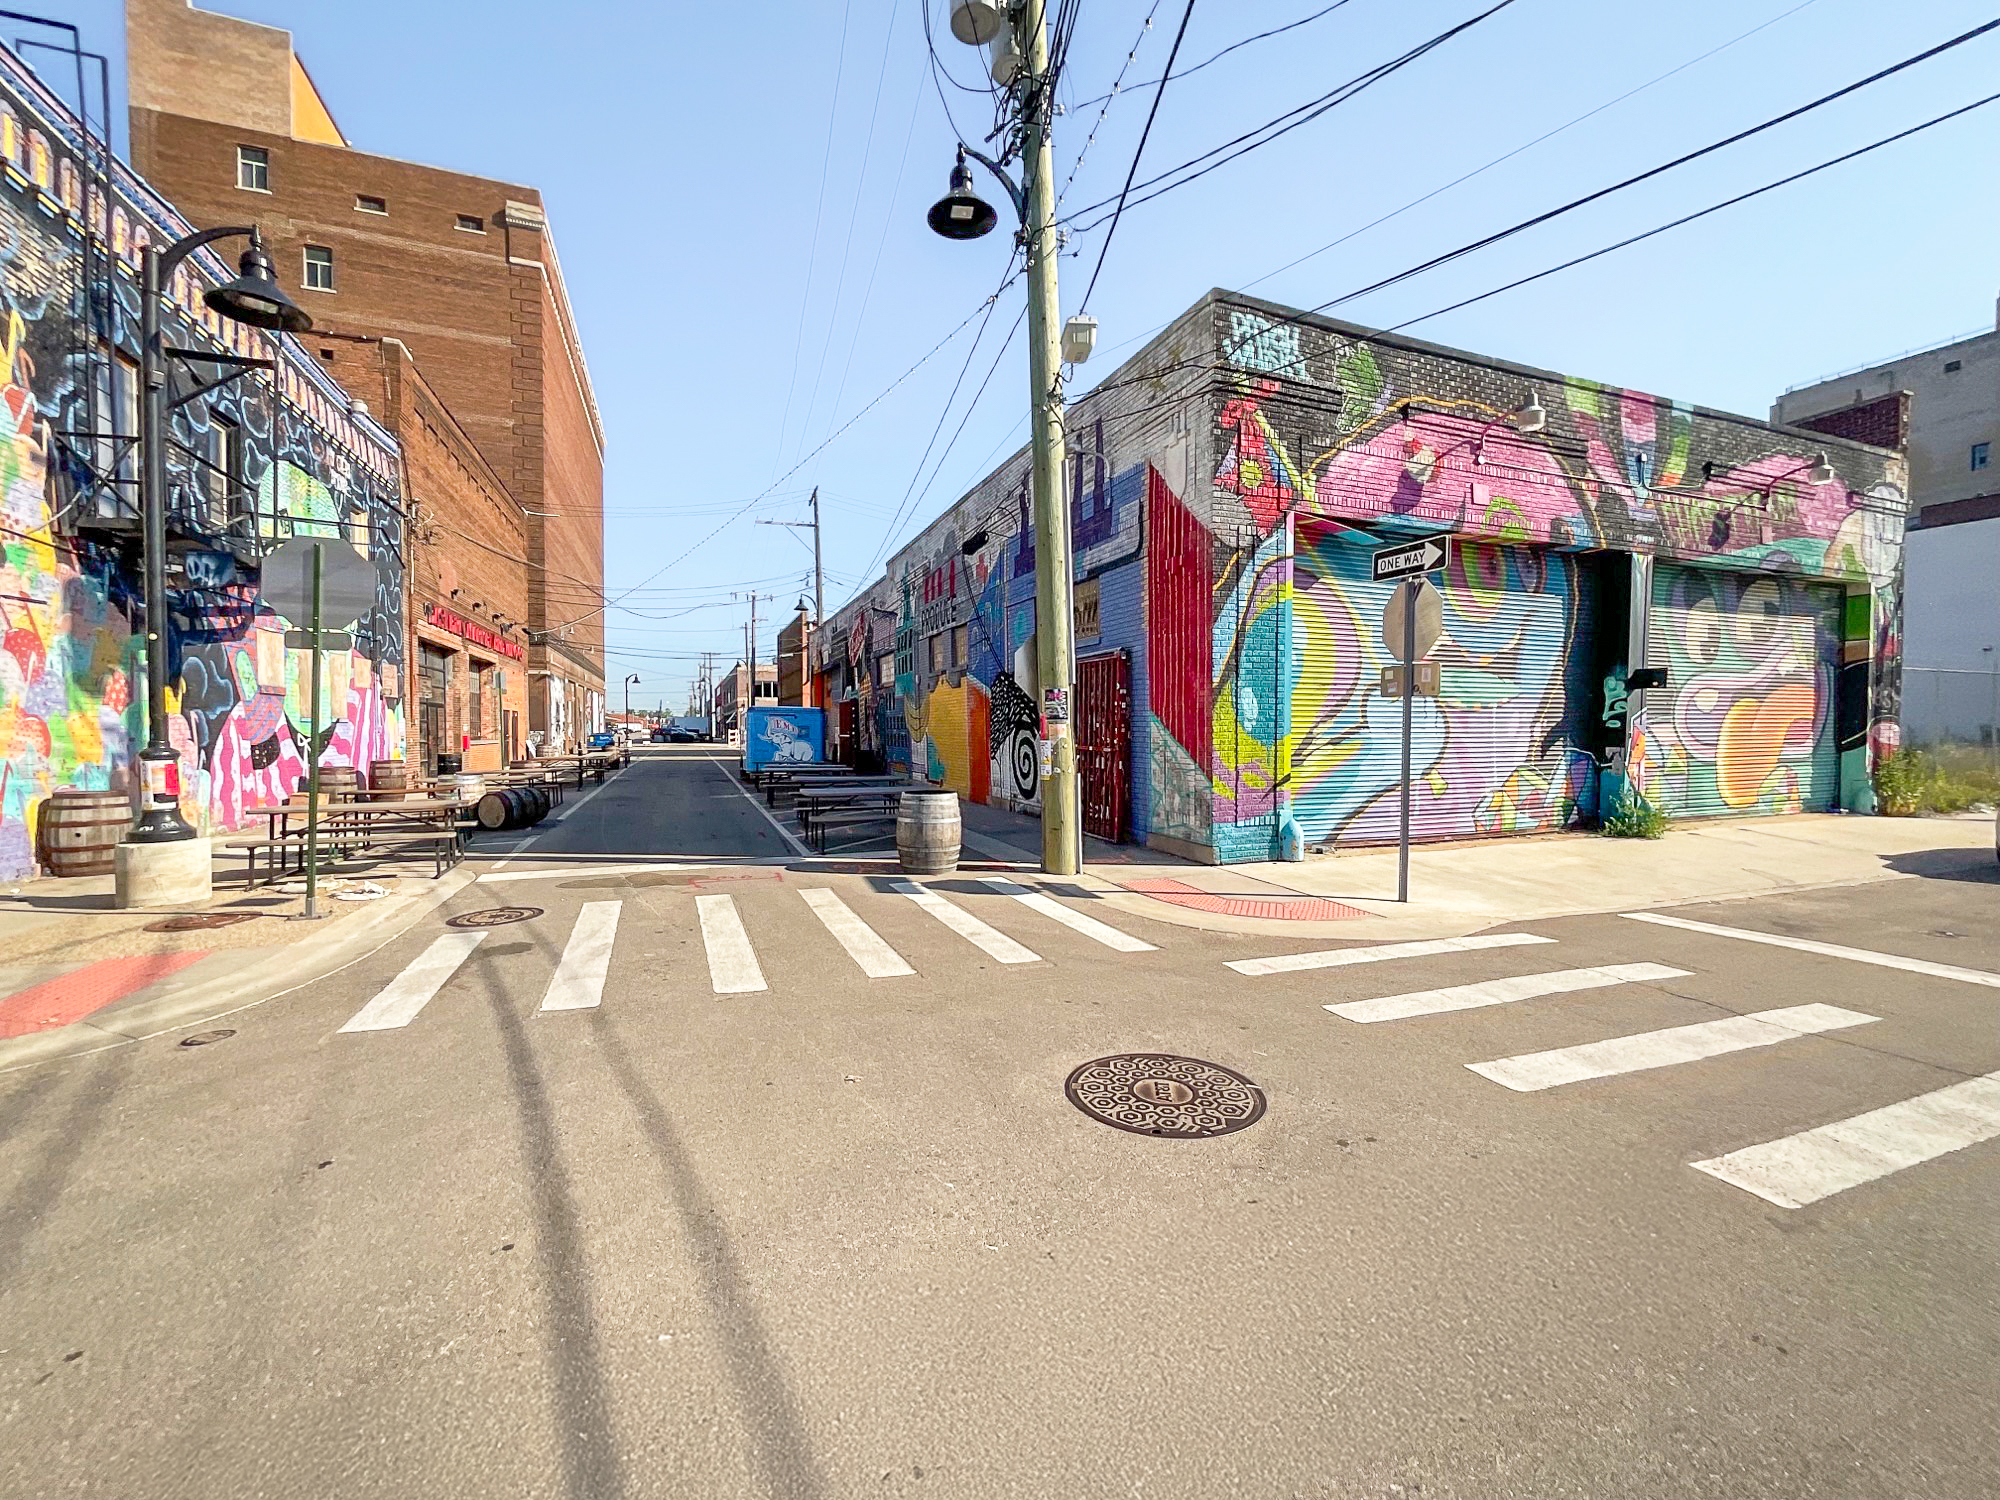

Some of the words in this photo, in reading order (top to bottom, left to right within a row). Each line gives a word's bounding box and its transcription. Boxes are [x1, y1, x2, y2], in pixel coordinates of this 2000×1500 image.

[1380, 556, 1401, 571] ONE
[1404, 550, 1426, 566] WAY
[921, 597, 956, 635] PRODUCE
[1154, 1081, 1173, 1102] AT&T
